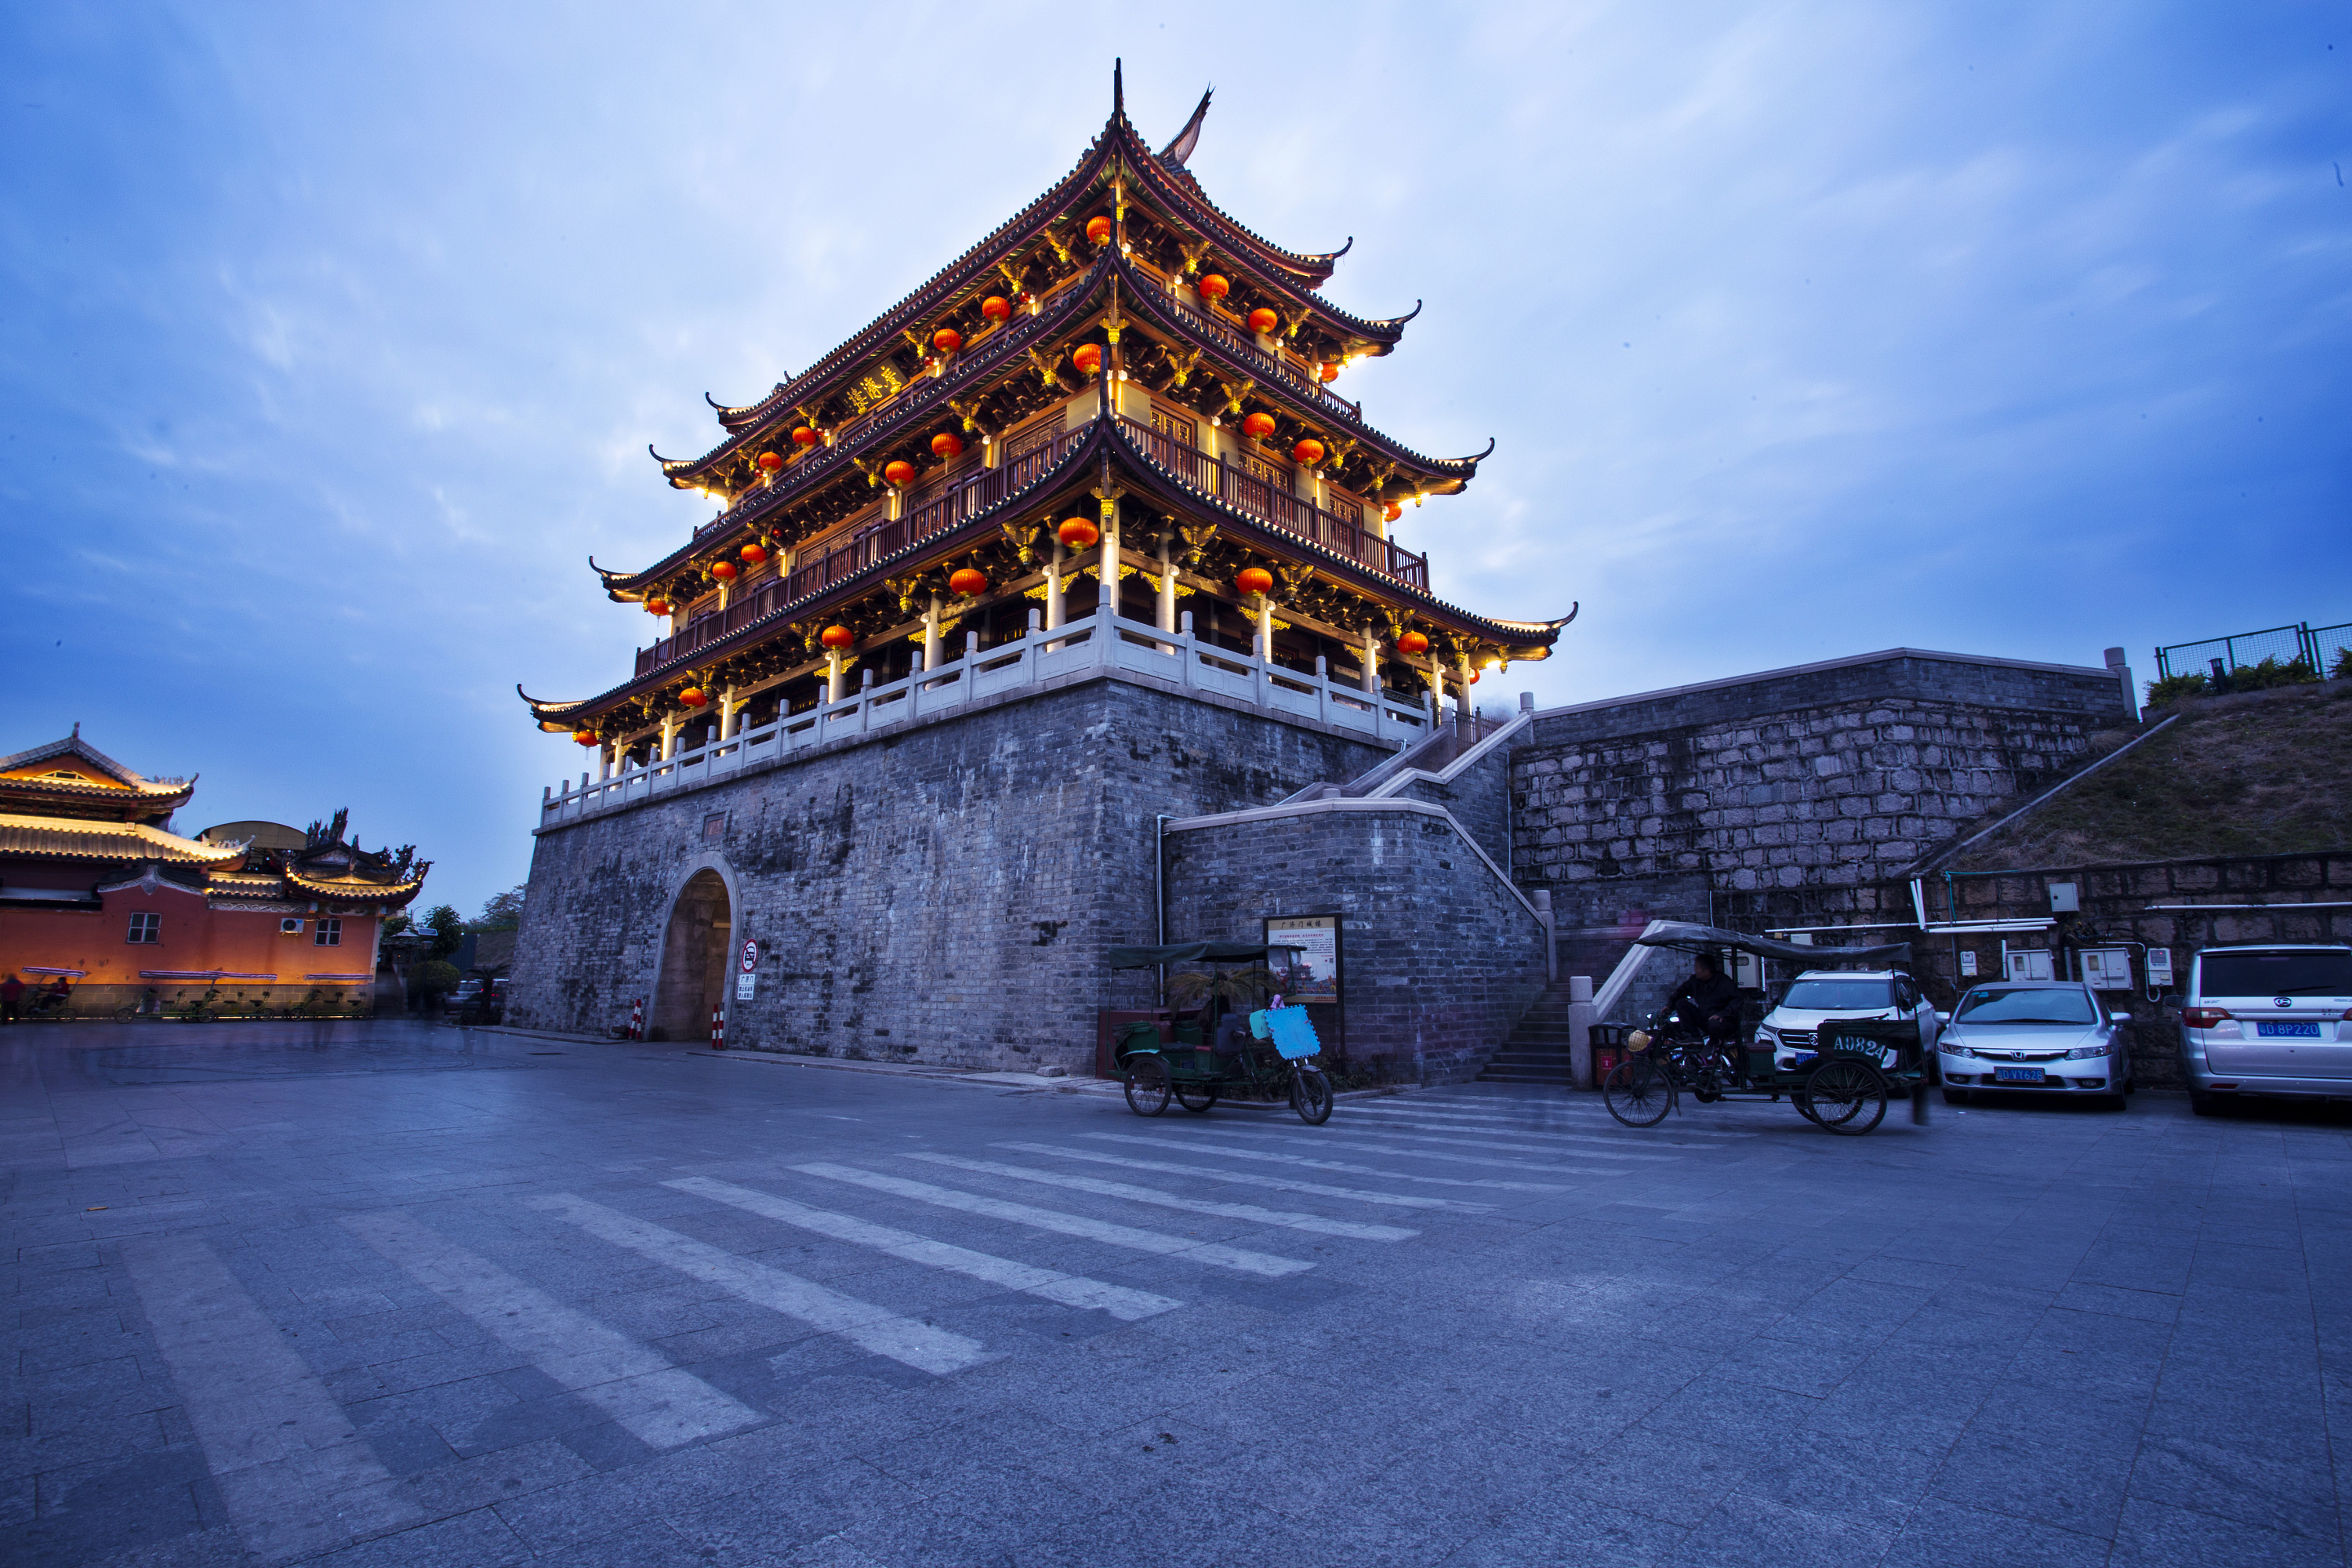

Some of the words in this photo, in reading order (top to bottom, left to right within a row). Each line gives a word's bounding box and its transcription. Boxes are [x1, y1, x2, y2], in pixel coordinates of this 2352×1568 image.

[1280, 919, 1322, 929] 广济门城楼
[1834, 1036, 1886, 1060] A0824
